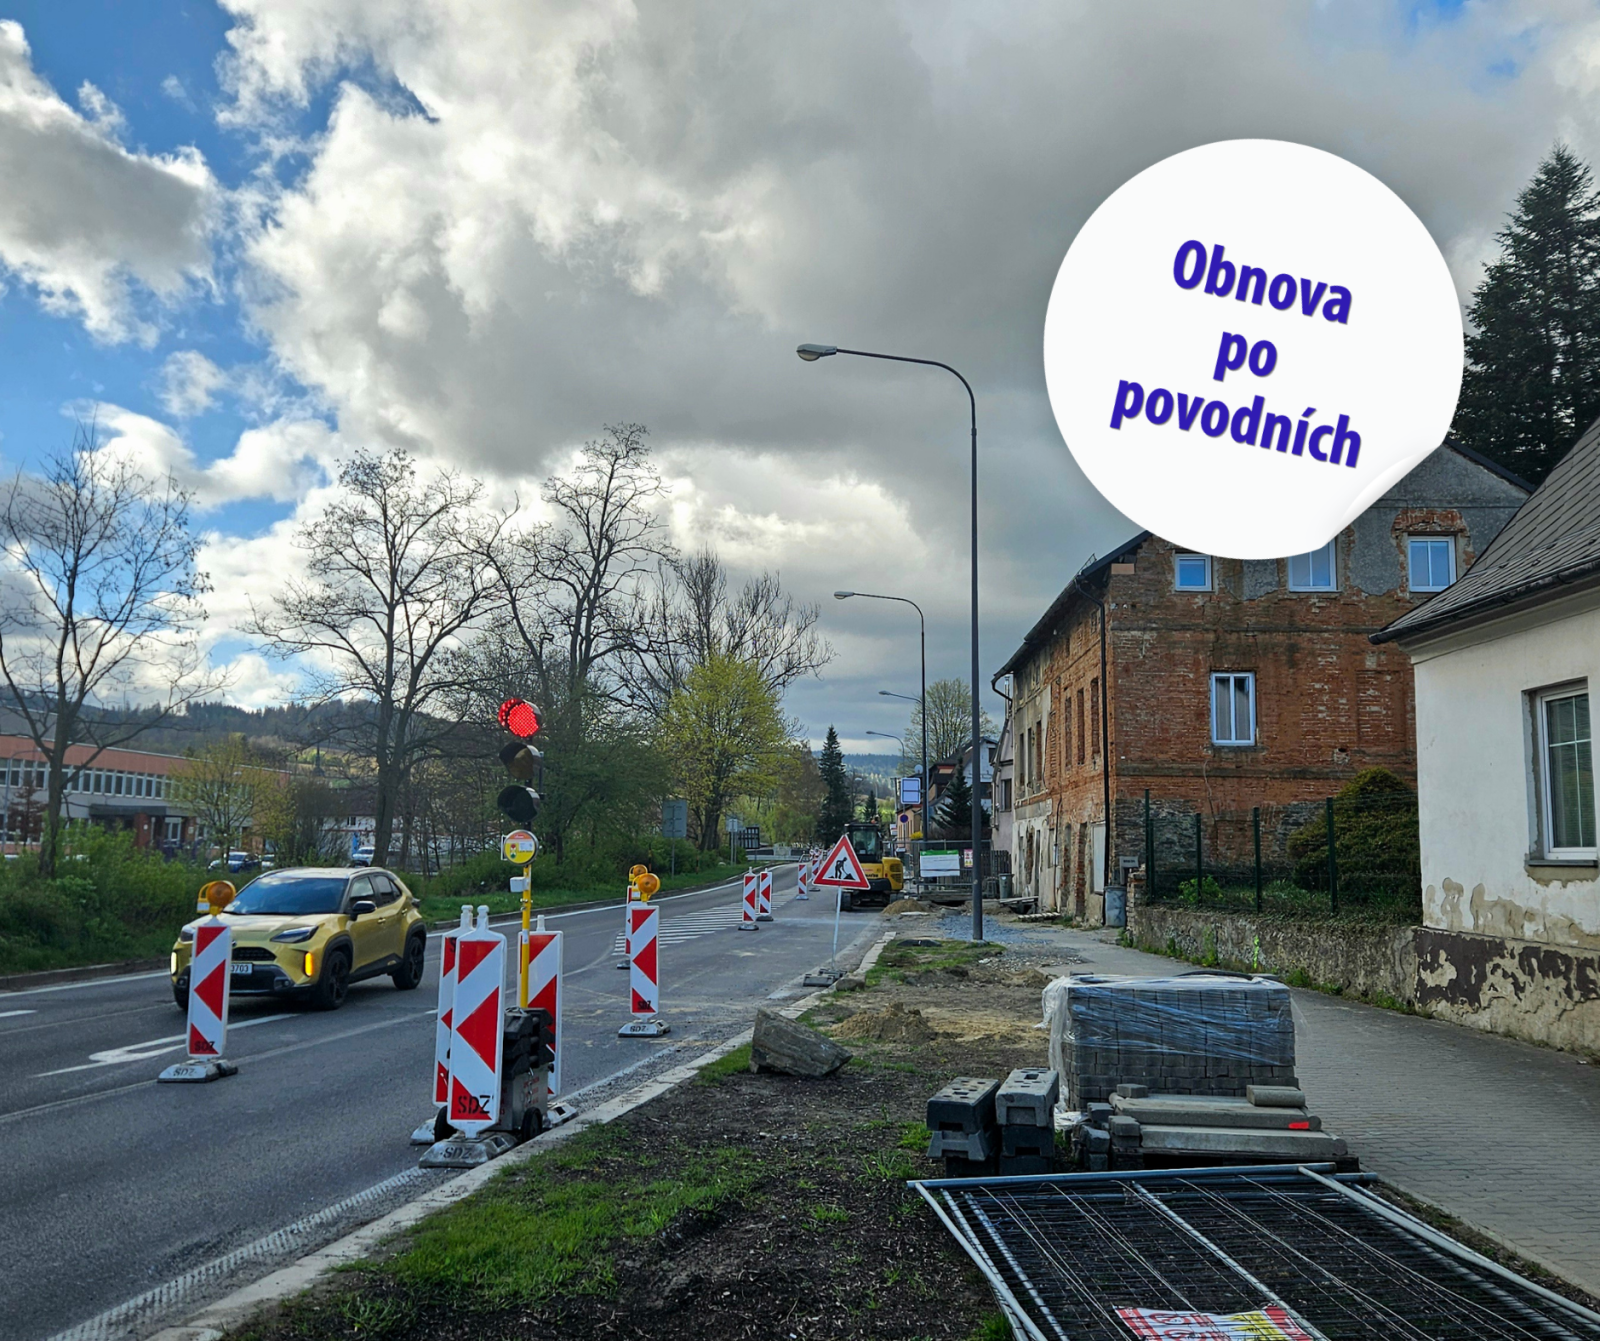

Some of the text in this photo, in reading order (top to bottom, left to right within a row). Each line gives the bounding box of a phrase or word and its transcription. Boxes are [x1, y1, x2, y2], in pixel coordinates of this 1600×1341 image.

[195, 1041, 215, 1052] SDZ
[173, 1067, 195, 1077] SDZ
[458, 1094, 490, 1114] SDZ
[443, 1147, 472, 1159] SDZ
